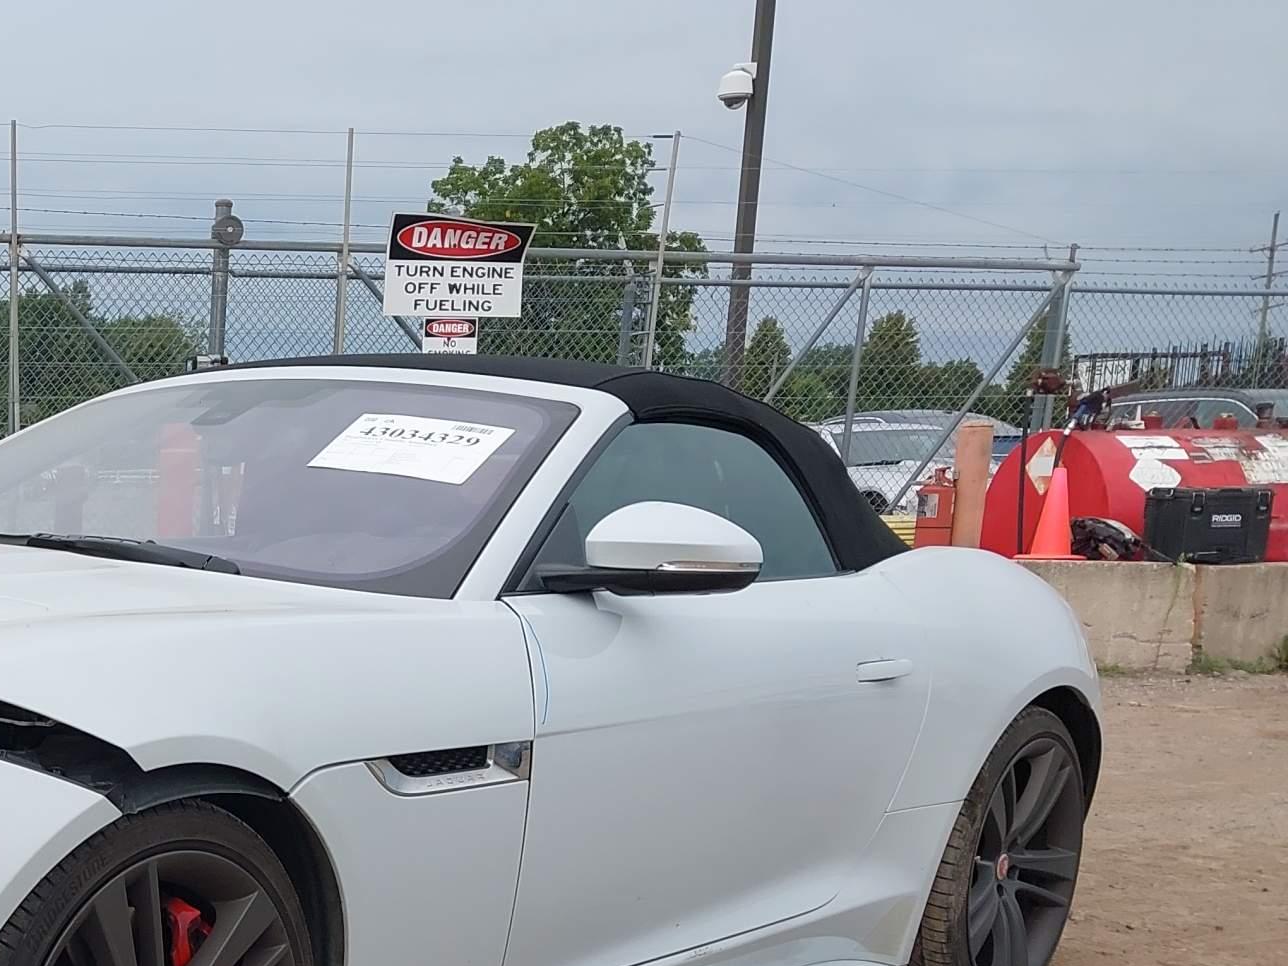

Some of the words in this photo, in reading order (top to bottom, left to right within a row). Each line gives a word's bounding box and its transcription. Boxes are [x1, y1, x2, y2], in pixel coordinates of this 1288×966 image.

[412, 227, 508, 249] DANGER
[395, 265, 444, 277] TURN
[450, 266, 514, 279] ENGINE
[404, 282, 440, 294] OFF
[448, 283, 503, 295] WHILE
[414, 299, 492, 312] FUELING
[432, 323, 469, 333] DANGER
[443, 340, 457, 348] NO
[360, 426, 481, 447] 43034329
[1212, 514, 1242, 522] RIDGID
